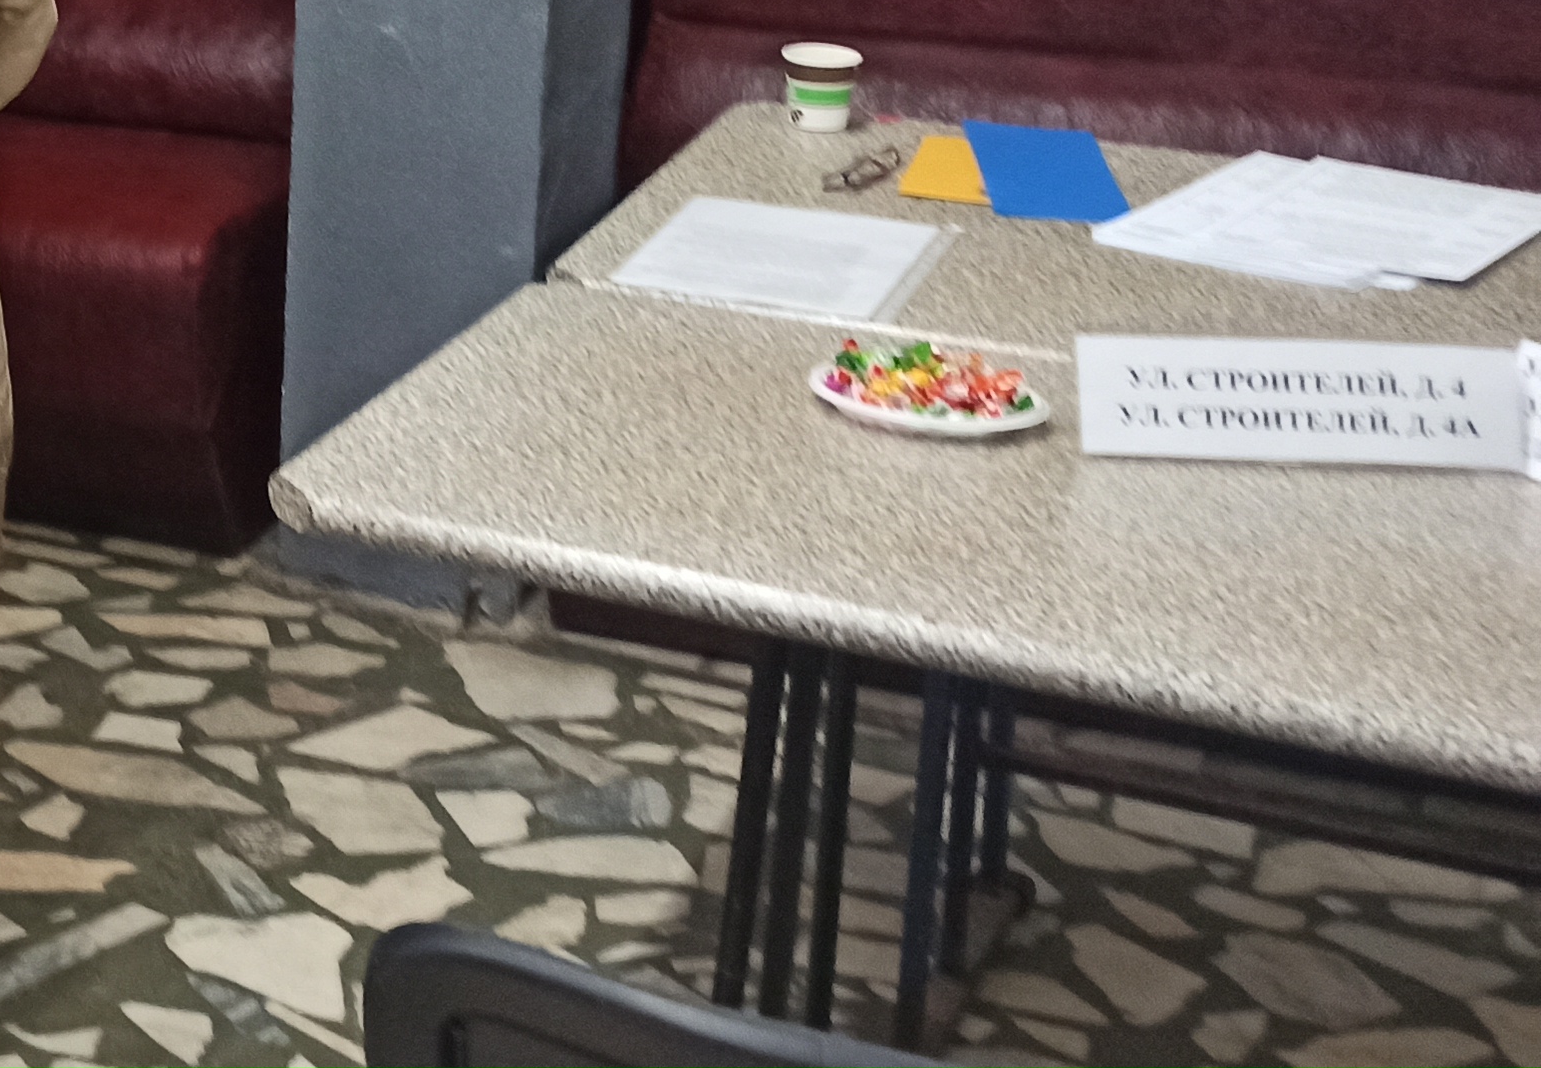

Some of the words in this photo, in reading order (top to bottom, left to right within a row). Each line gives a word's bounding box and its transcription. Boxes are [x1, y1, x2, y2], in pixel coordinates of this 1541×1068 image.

[1125, 364, 1178, 390] УЛ.
[1415, 373, 1445, 401] Д.
[1450, 377, 1466, 398] 4
[1117, 403, 1169, 428] УЛ.
[1406, 413, 1436, 438] Д.
[1443, 414, 1481, 439] 4А
